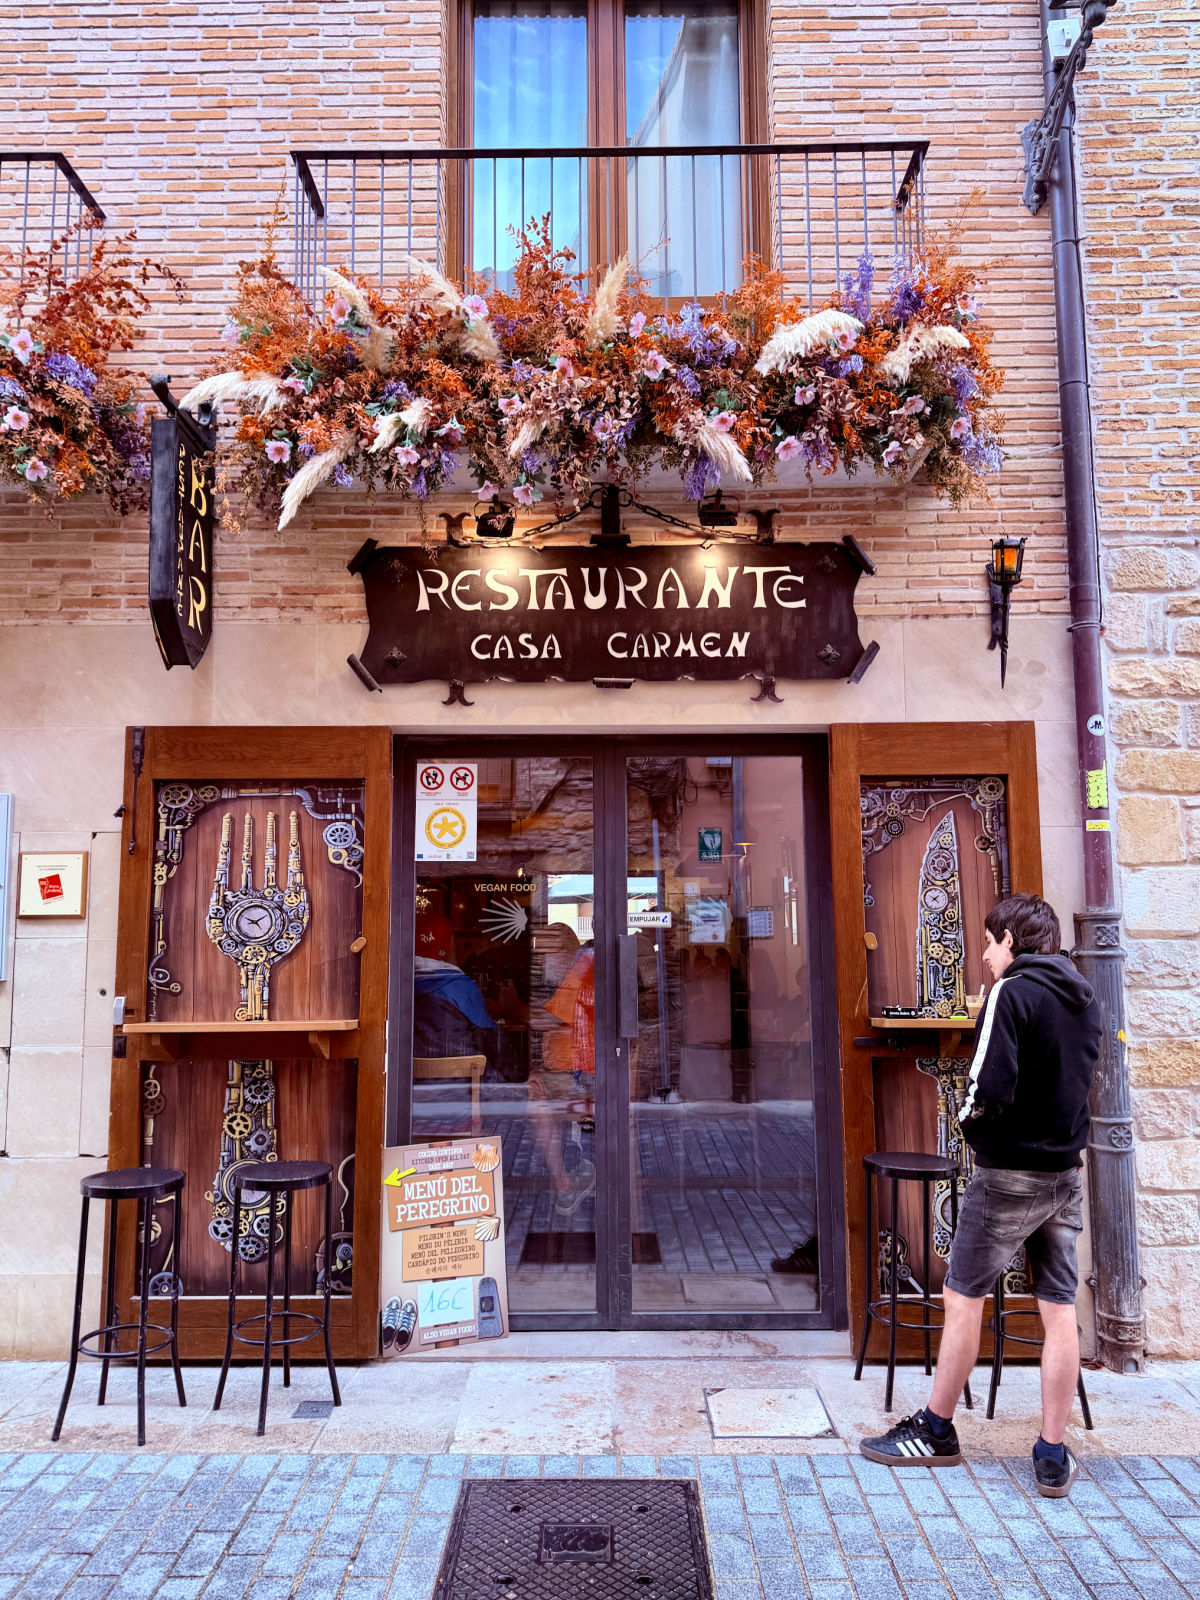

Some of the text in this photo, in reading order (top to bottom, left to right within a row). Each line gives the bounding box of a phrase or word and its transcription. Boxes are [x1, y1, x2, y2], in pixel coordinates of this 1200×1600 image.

[187, 454, 208, 636] BAR
[415, 566, 807, 612] RESTAURANTE
[470, 631, 751, 660] CASA CARMEN
[474, 883, 537, 892] VEGAN FOOD
[411, 1157, 434, 1165] KITCHEN
[435, 1155, 449, 1163] OPEN
[403, 1175, 482, 1201] MENÚ DEL
[396, 1194, 490, 1223] PEREGRINO
[417, 1242, 433, 1250] MENU
[427, 1250, 439, 1258] DEL
[440, 1245, 476, 1256] PELLEGRINO
[447, 1253, 480, 1263] PEREGRINO
[423, 1330, 438, 1339] ALSO
[439, 1327, 457, 1337] VEGAN
